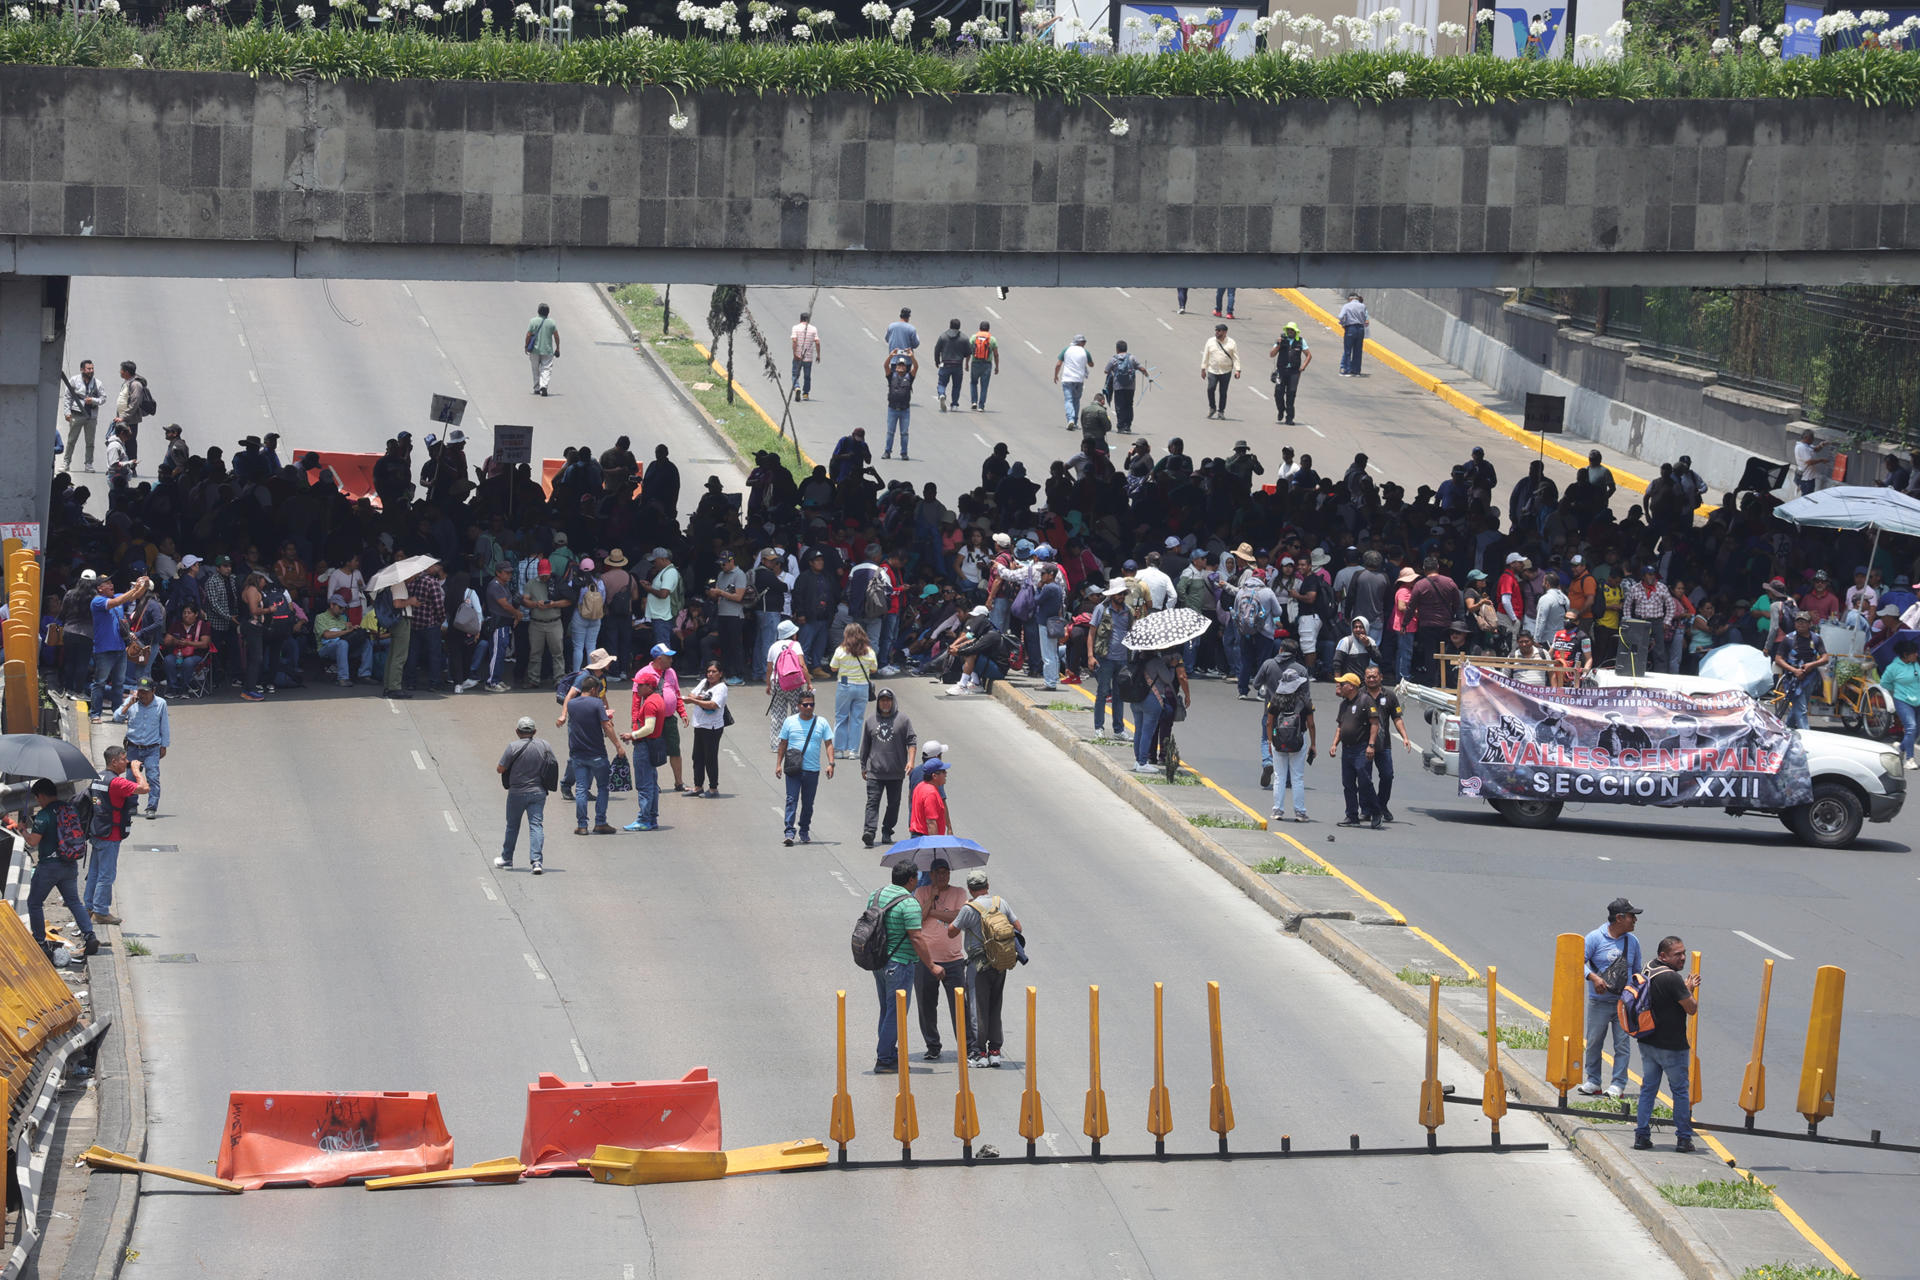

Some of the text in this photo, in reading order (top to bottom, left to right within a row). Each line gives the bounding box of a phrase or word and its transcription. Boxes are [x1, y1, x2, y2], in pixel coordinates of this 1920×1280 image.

[11, 528, 32, 537] ETLA
[1564, 688, 1609, 697] NACIONAL
[1616, 689, 1628, 697] DE
[1548, 696, 1593, 706] NACIONAL
[1597, 698, 1609, 706] DE
[1501, 740, 1783, 774] VALLES CENTRALES
[1533, 771, 1759, 798] SECCIÓN XXII
